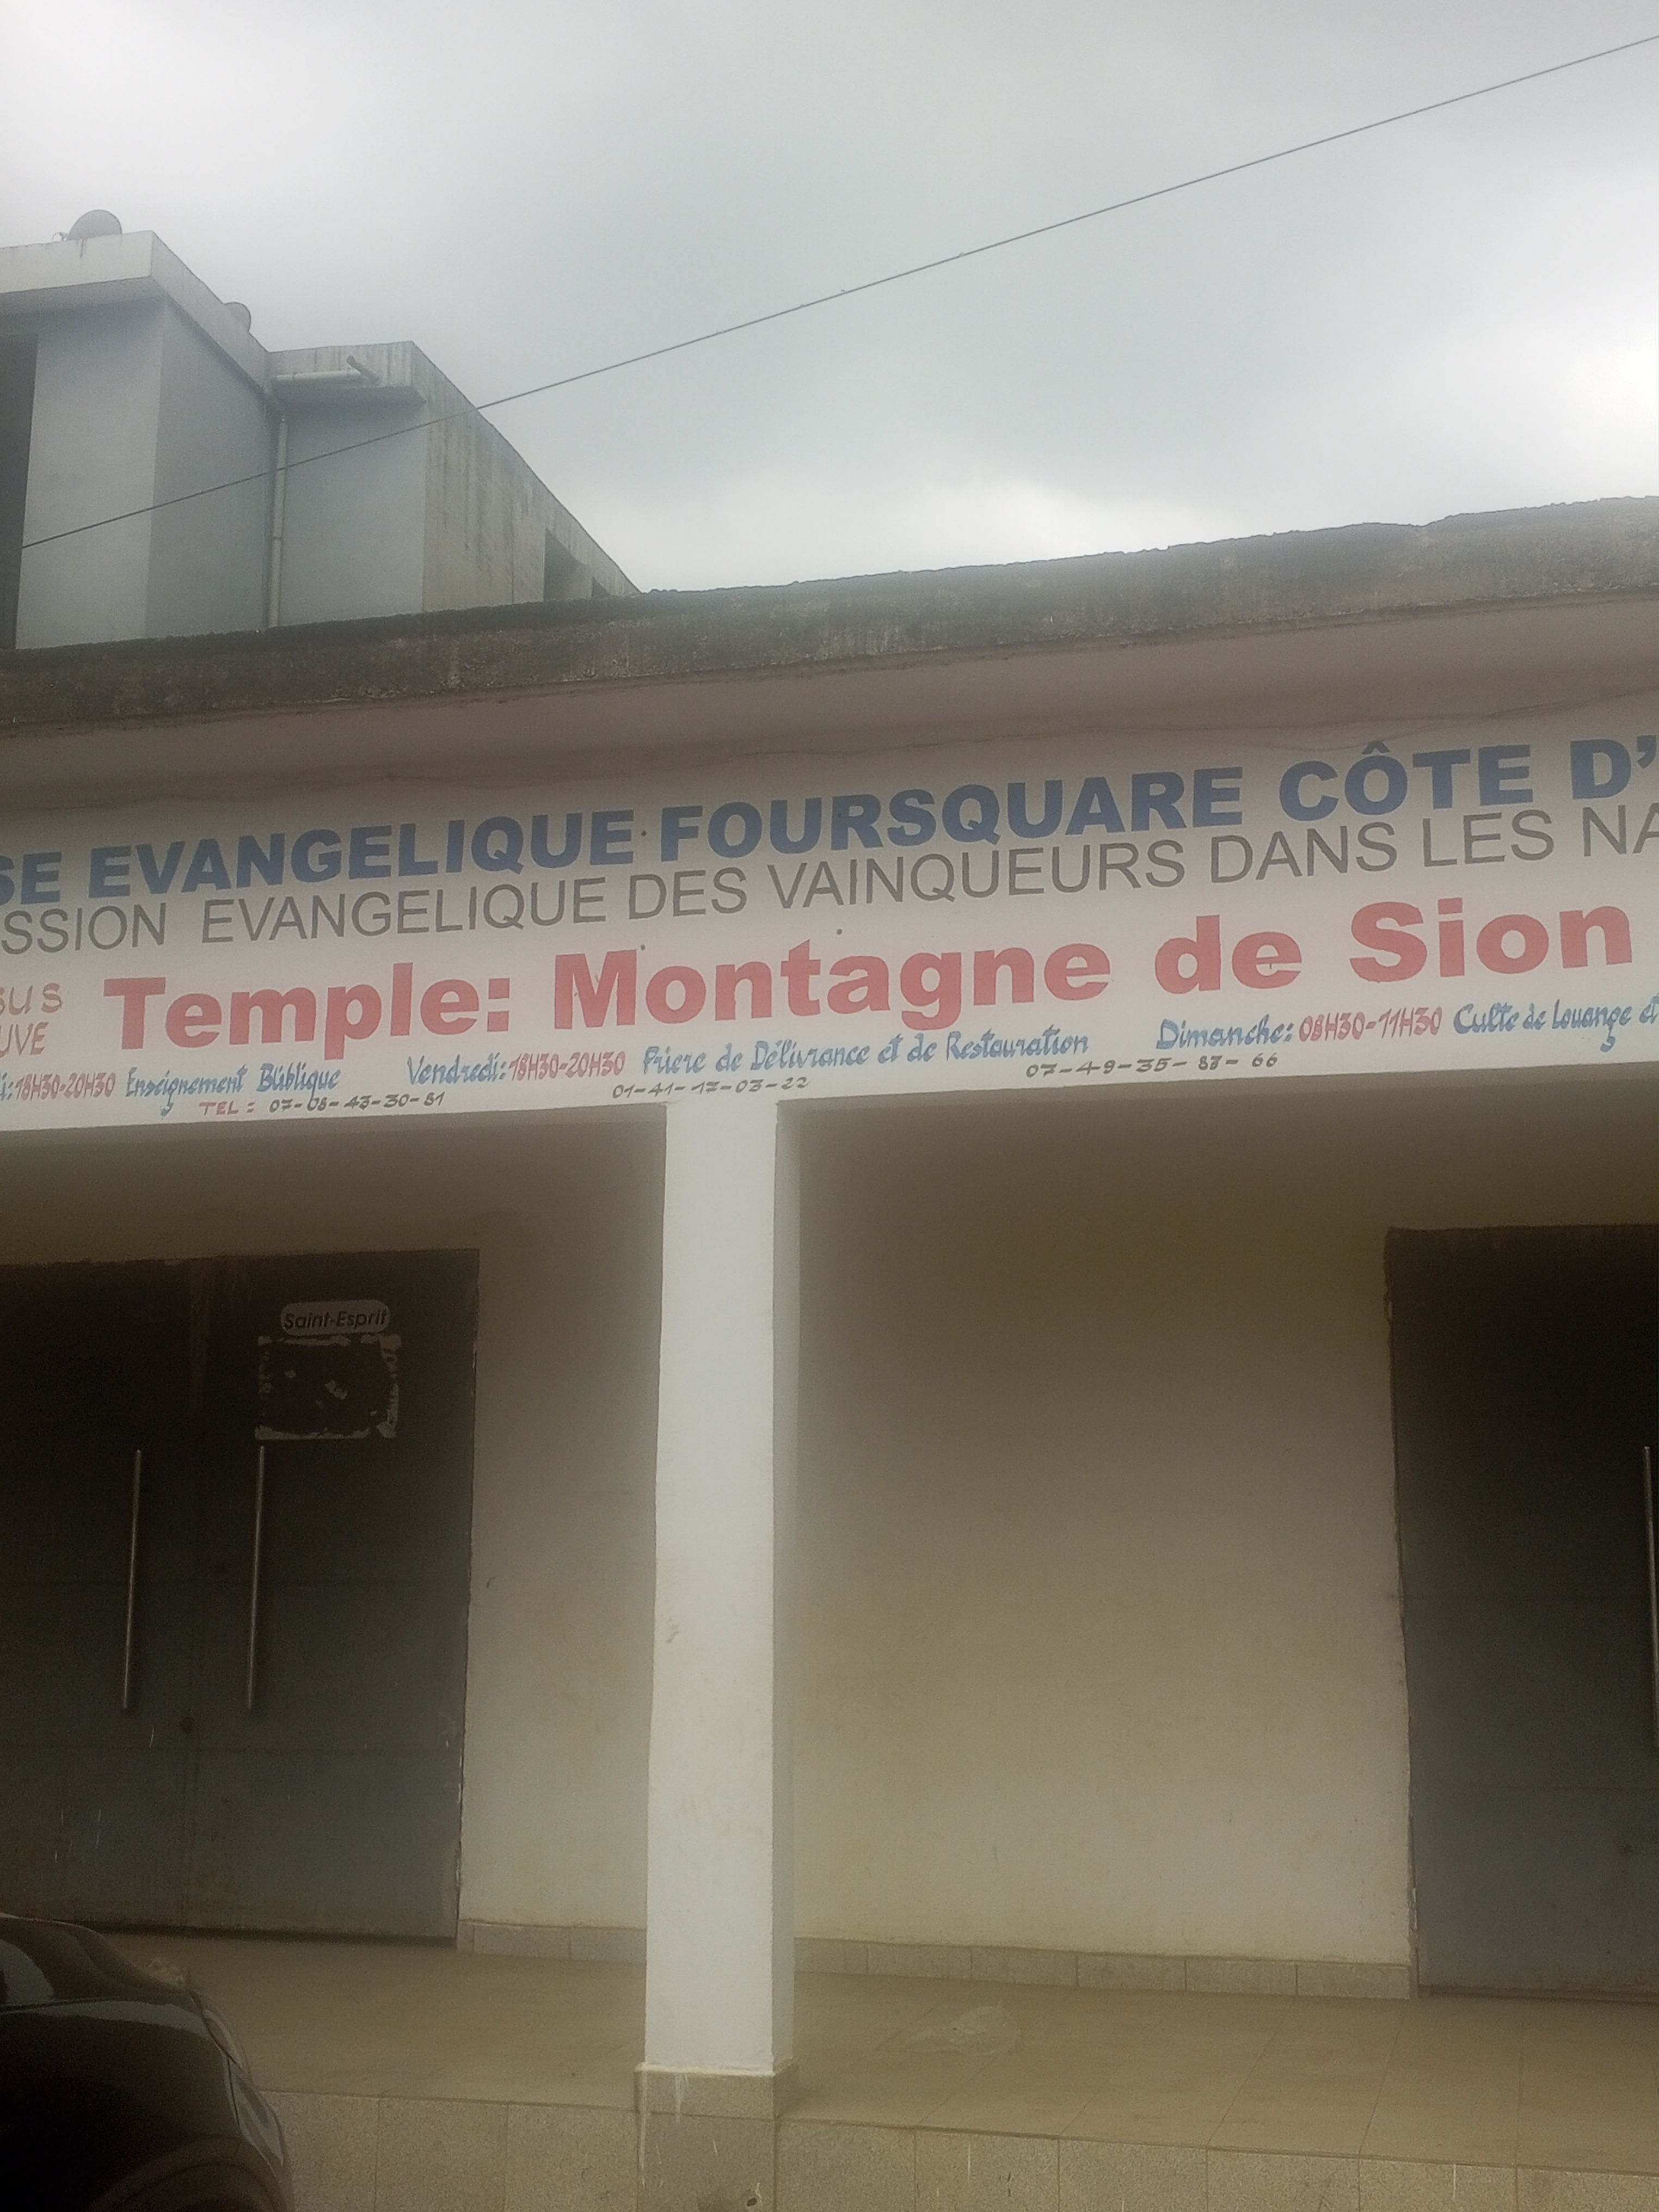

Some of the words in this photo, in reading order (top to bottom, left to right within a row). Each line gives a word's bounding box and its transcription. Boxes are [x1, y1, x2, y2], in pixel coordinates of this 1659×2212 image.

[88, 809, 635, 899] EVANGELIQUE
[661, 766, 1243, 862] FOURSQUARE
[1279, 740, 1533, 822] CÔTE
[2, 902, 166, 955] SSION
[201, 876, 606, 944] EVANGELIQUE
[629, 867, 748, 920] DES
[767, 839, 1185, 910] VAINQUEURS
[1211, 822, 1398, 883] DANS
[1422, 809, 1555, 867] LES
[0, 982, 63, 1016] US
[103, 962, 511, 1061] Temple:
[554, 939, 1111, 1031] Montagne
[1154, 914, 1302, 994] de
[1349, 897, 1632, 983] Sion
[716, 1043, 743, 1072] de
[750, 1039, 870, 1071] Délivrance
[877, 1033, 904, 1065] et
[907, 1033, 938, 1063] de
[947, 1024, 1089, 1061] Restauration
[1156, 1014, 1294, 1049] Dimanche:
[1453, 1002, 1519, 1034] Culte
[1522, 1003, 1546, 1030] de
[1552, 999, 1632, 1052] Louange
[285, 1310, 388, 1330] Saint-Esprit
